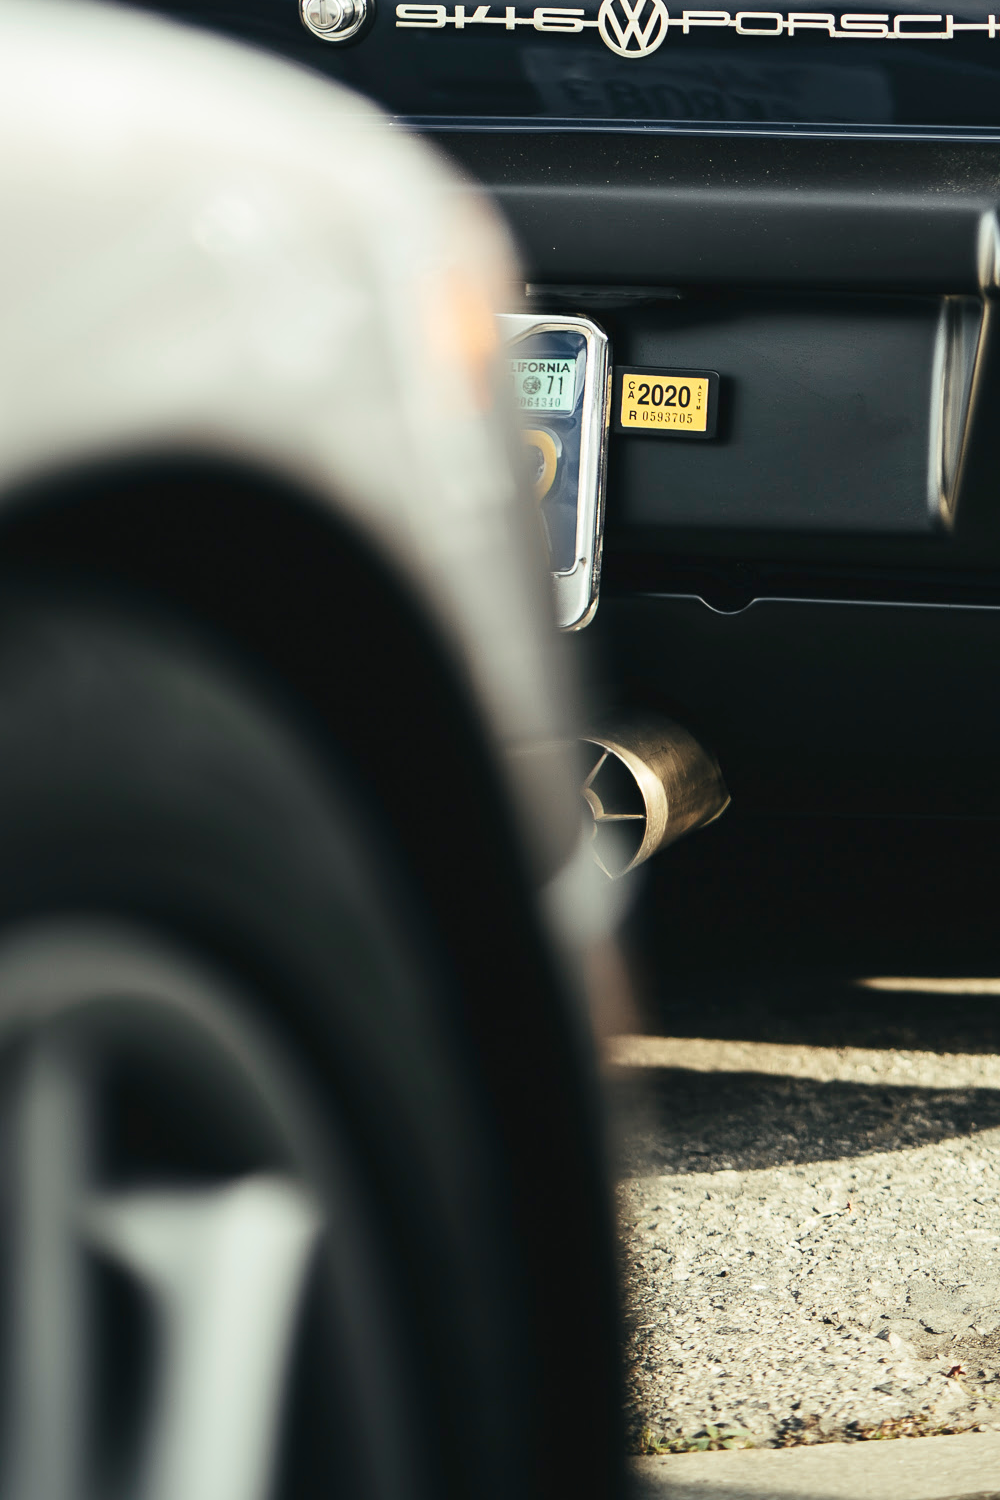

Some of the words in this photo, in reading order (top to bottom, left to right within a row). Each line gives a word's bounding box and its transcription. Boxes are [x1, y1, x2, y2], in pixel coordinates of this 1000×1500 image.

[510, 361, 571, 373] LIFORNIA
[547, 375, 564, 395] 71
[514, 397, 561, 408] 064340
[637, 383, 691, 408] 2020
[629, 410, 637, 420] R
[642, 410, 693, 424] 0593705
